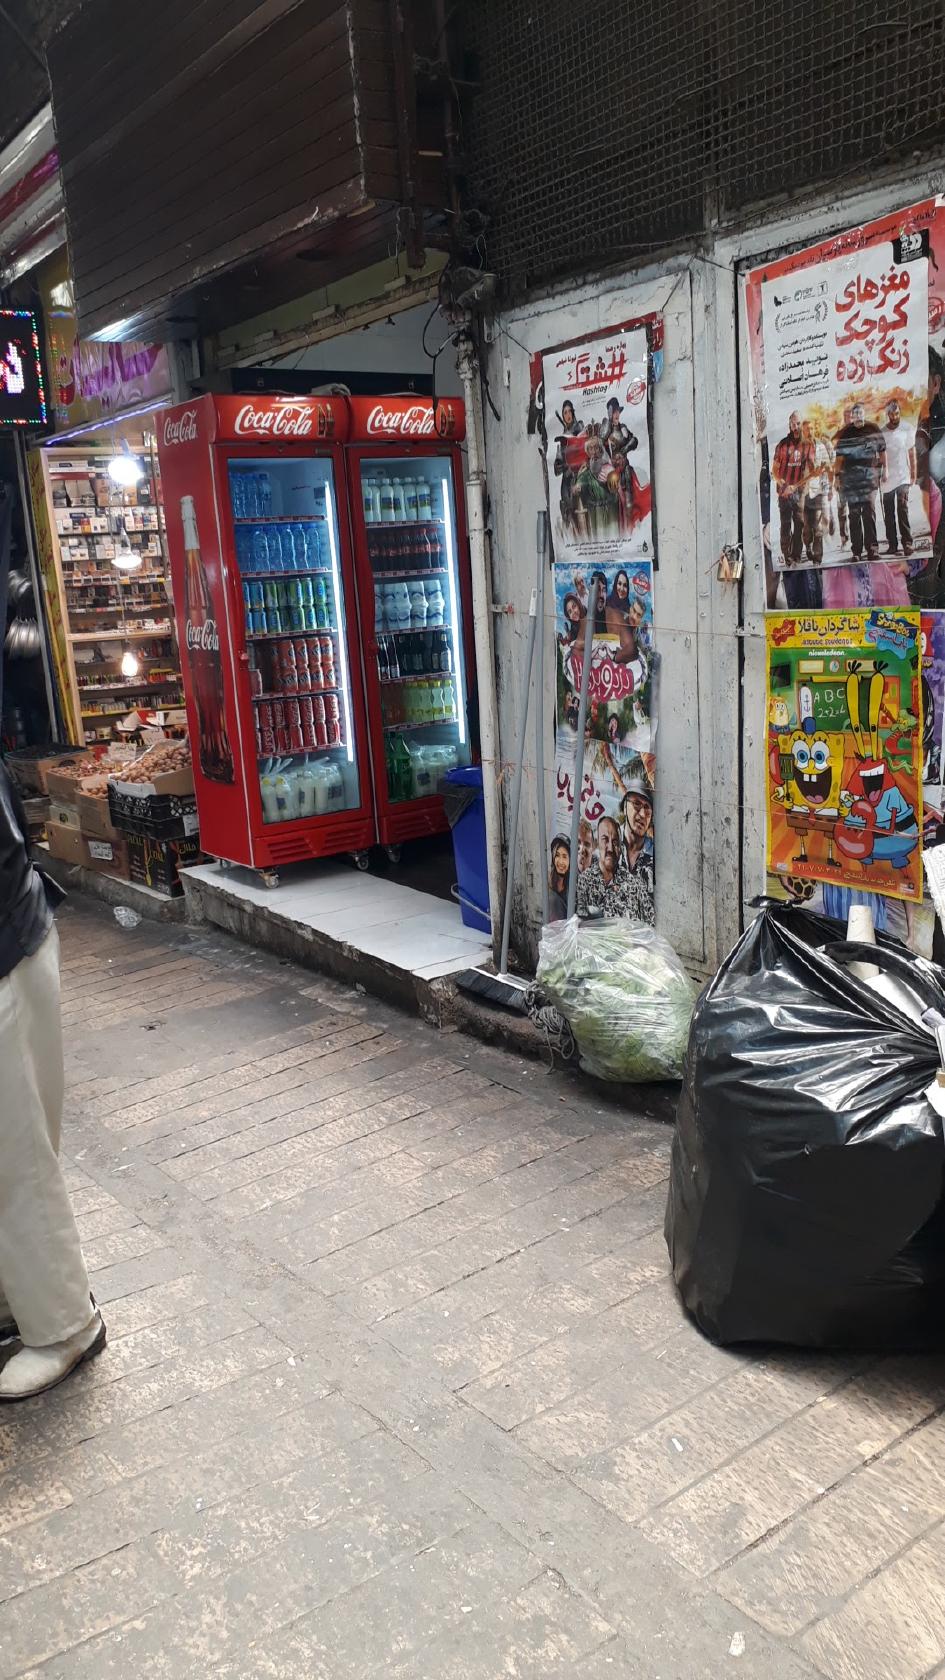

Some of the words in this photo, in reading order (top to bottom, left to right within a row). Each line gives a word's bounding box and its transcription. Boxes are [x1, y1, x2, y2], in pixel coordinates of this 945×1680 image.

[835, 265, 910, 313] مغزهای
[835, 293, 910, 352] کوچک
[582, 384, 608, 396] Hashtag
[163, 409, 199, 446] Coca-Cola
[233, 404, 315, 436] Coca-Cola
[366, 404, 435, 436] Coca-Cola
[185, 619, 220, 651] Coca-Cola
[798, 618, 818, 633] ناقلا
[819, 617, 860, 636] شاگردان
[814, 692, 820, 704] A
[824, 689, 833, 703] B
[836, 688, 845, 698] C
